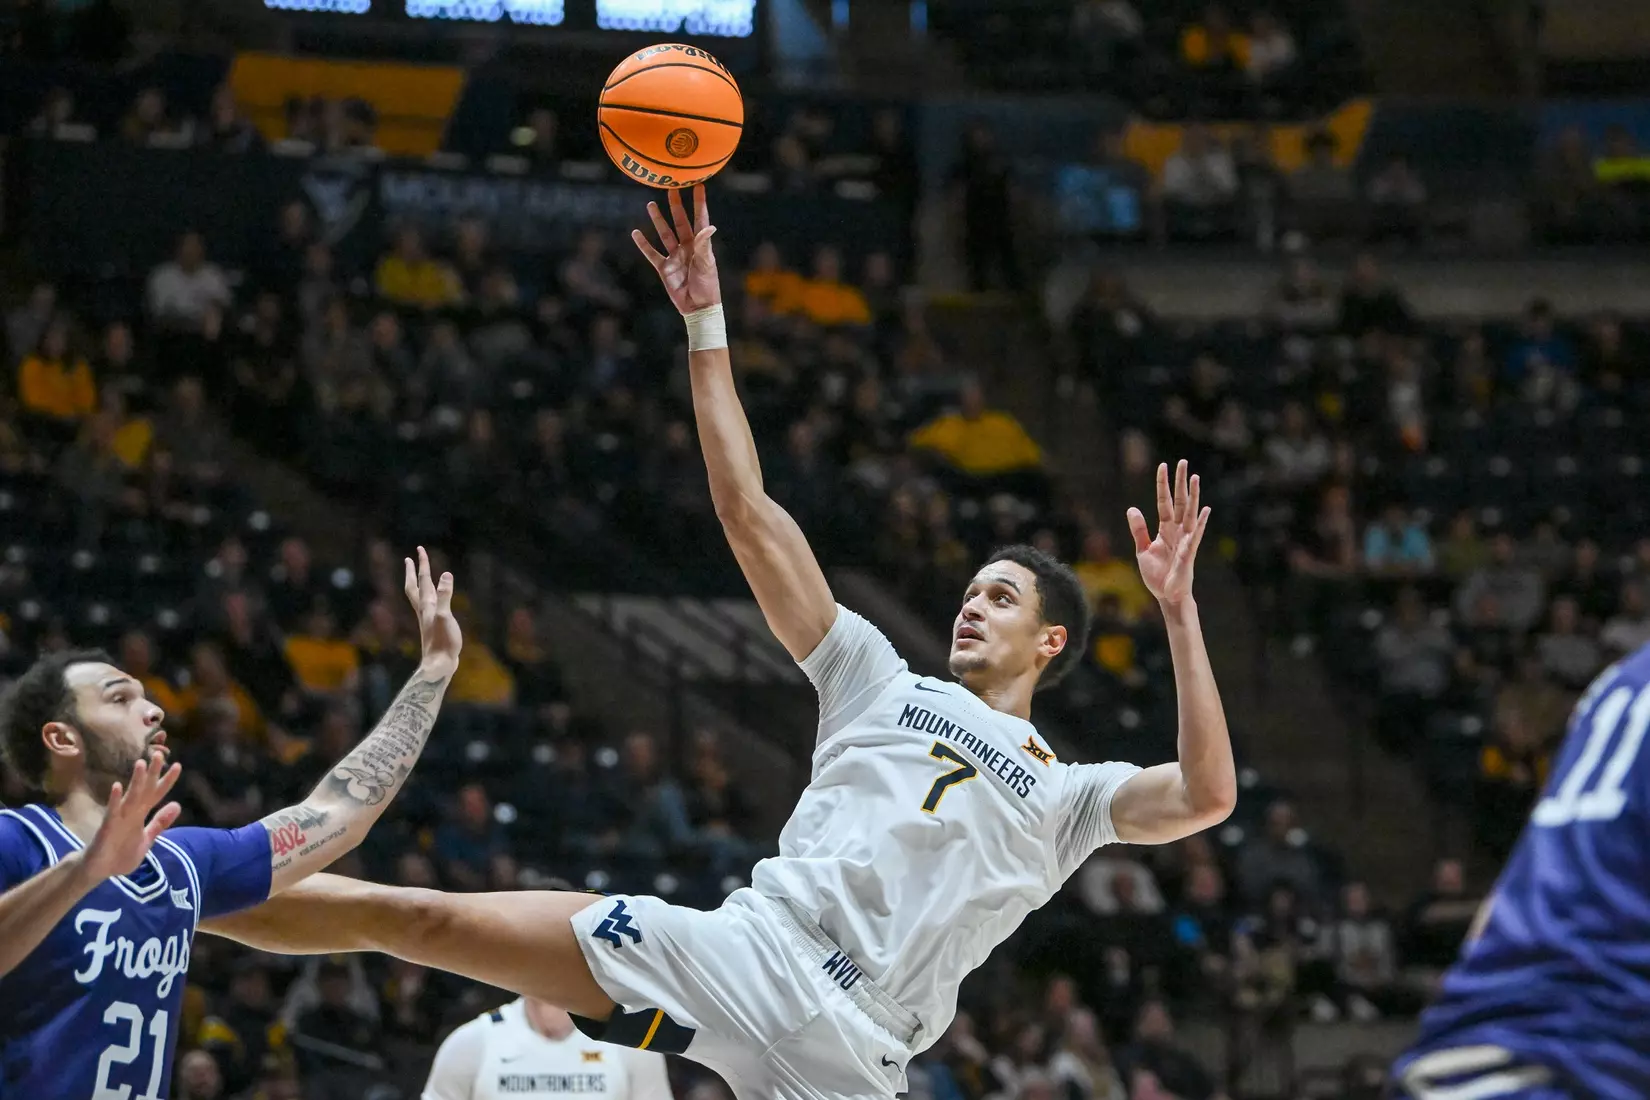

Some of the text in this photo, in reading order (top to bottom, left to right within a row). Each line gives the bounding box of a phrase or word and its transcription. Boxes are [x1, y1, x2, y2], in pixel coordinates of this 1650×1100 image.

[898, 704, 1036, 798] MOUNTAINEERS
[920, 740, 979, 814] 7
[272, 821, 306, 856] 402
[74, 908, 190, 999] Frogs
[822, 950, 863, 991] WVU
[91, 1001, 169, 1100] 21
[498, 1074, 606, 1094] MOUNTAINEERS
